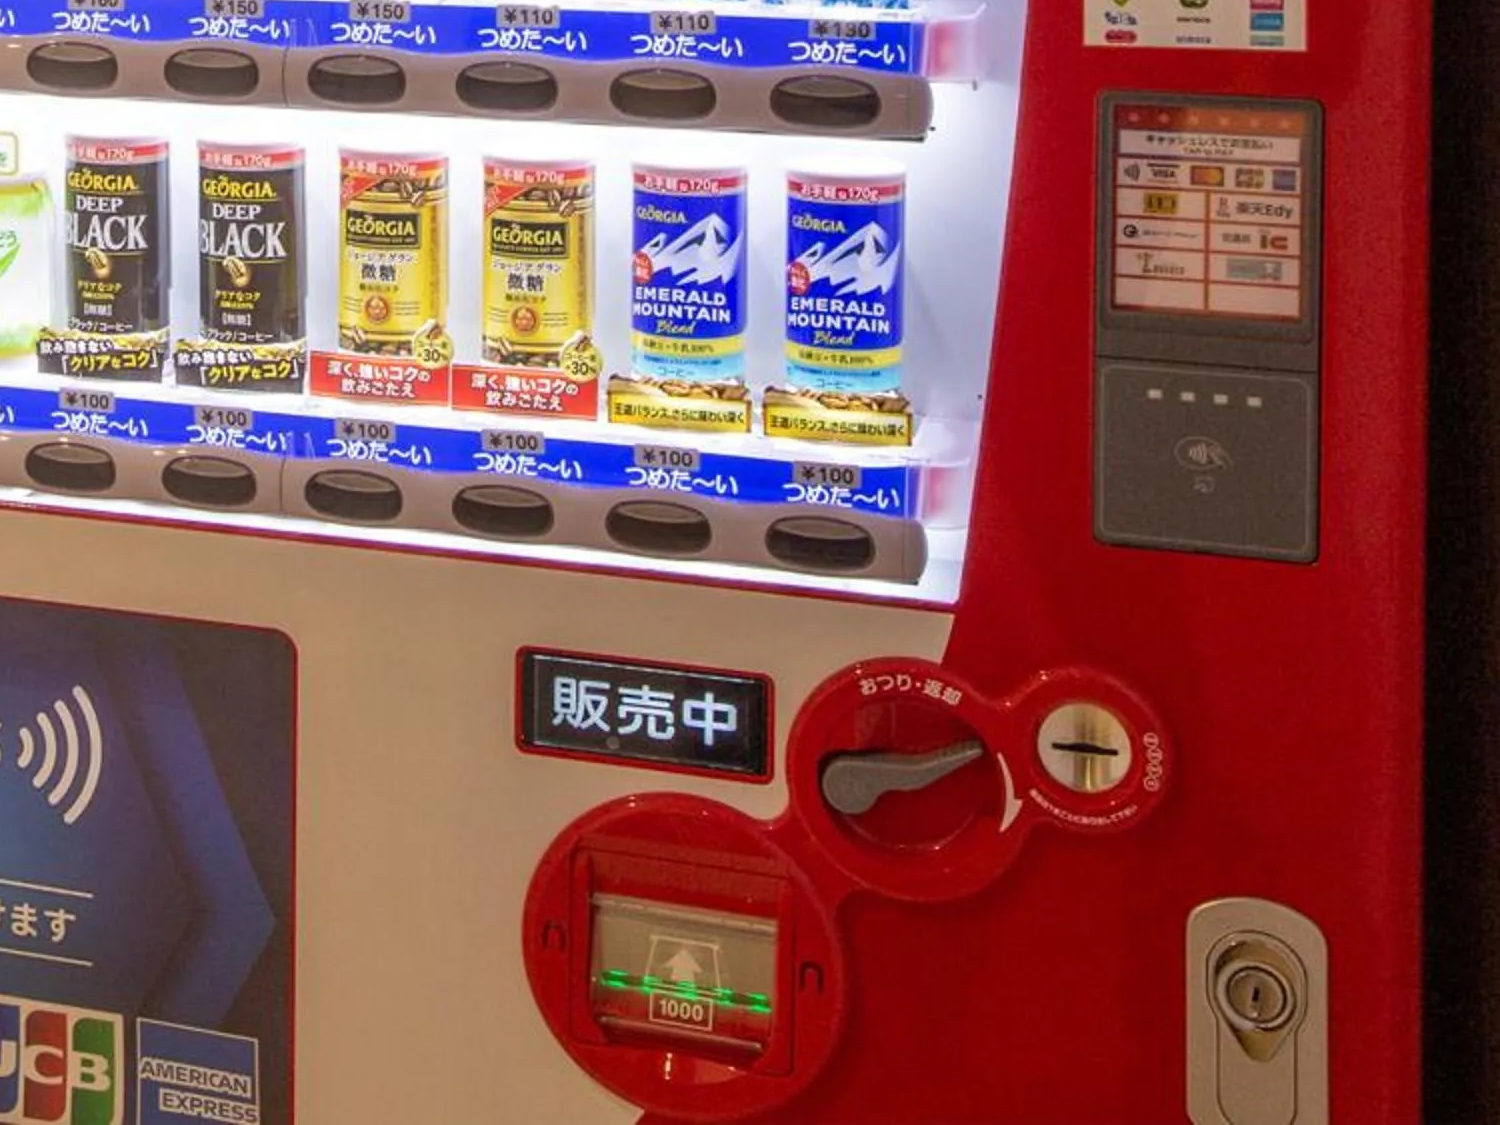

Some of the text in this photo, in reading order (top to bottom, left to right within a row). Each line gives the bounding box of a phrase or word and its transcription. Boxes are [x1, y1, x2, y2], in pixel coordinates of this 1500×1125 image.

[212, 0, 259, 16] ¥150
[355, 3, 405, 20] ¥150
[503, 9, 554, 26] ¥110
[658, 13, 710, 31] ¥110
[813, 21, 871, 38] ¥130
[68, 167, 138, 191] GEORGIA
[202, 174, 276, 199] GEORGIA
[75, 195, 124, 214] DEEP
[212, 202, 261, 220] DEEP
[635, 205, 687, 225] GEORGIA
[791, 212, 847, 233] GEORGIA
[347, 214, 416, 237] GEORGIA
[492, 222, 565, 248] GEORGIA
[635, 286, 728, 307] EMERALD
[791, 295, 886, 316] EMERALD
[633, 302, 732, 324] MOUNTAIN
[655, 318, 698, 337] Blend
[787, 312, 891, 335] MOUNTAIN
[813, 329, 857, 348] Blend
[340, 378, 416, 399] 飲みごたえ
[63, 392, 110, 409] ¥100
[485, 390, 564, 412] 飲みごたえ
[201, 410, 248, 426] ¥100
[340, 423, 390, 439] ¥100
[489, 433, 538, 449] ¥100
[642, 450, 693, 467] ¥100
[802, 466, 855, 484] ¥100
[551, 675, 739, 748] 販売中
[658, 997, 705, 1023] 1000
[139, 1056, 249, 1096] AMERICAN
[161, 1090, 258, 1125] EXPRESS
